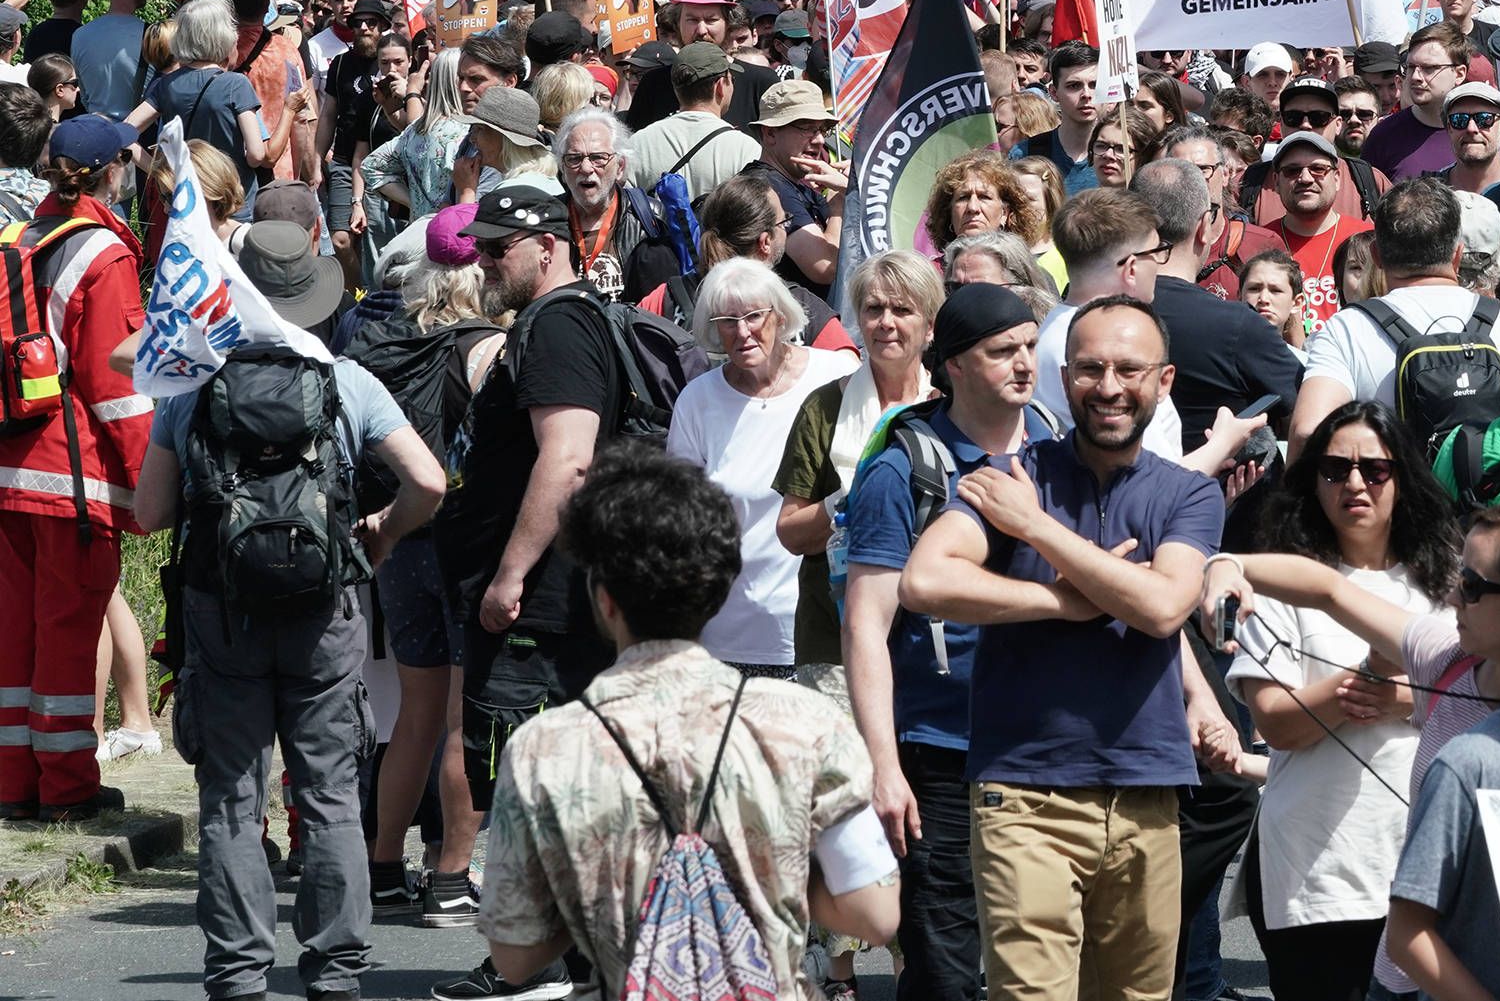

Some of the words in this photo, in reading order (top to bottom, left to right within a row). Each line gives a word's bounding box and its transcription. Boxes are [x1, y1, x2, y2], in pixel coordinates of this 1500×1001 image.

[443, 17, 487, 32] STOPPEN!
[616, 13, 649, 32] STOPPEN!
[1453, 388, 1477, 397] deuter
